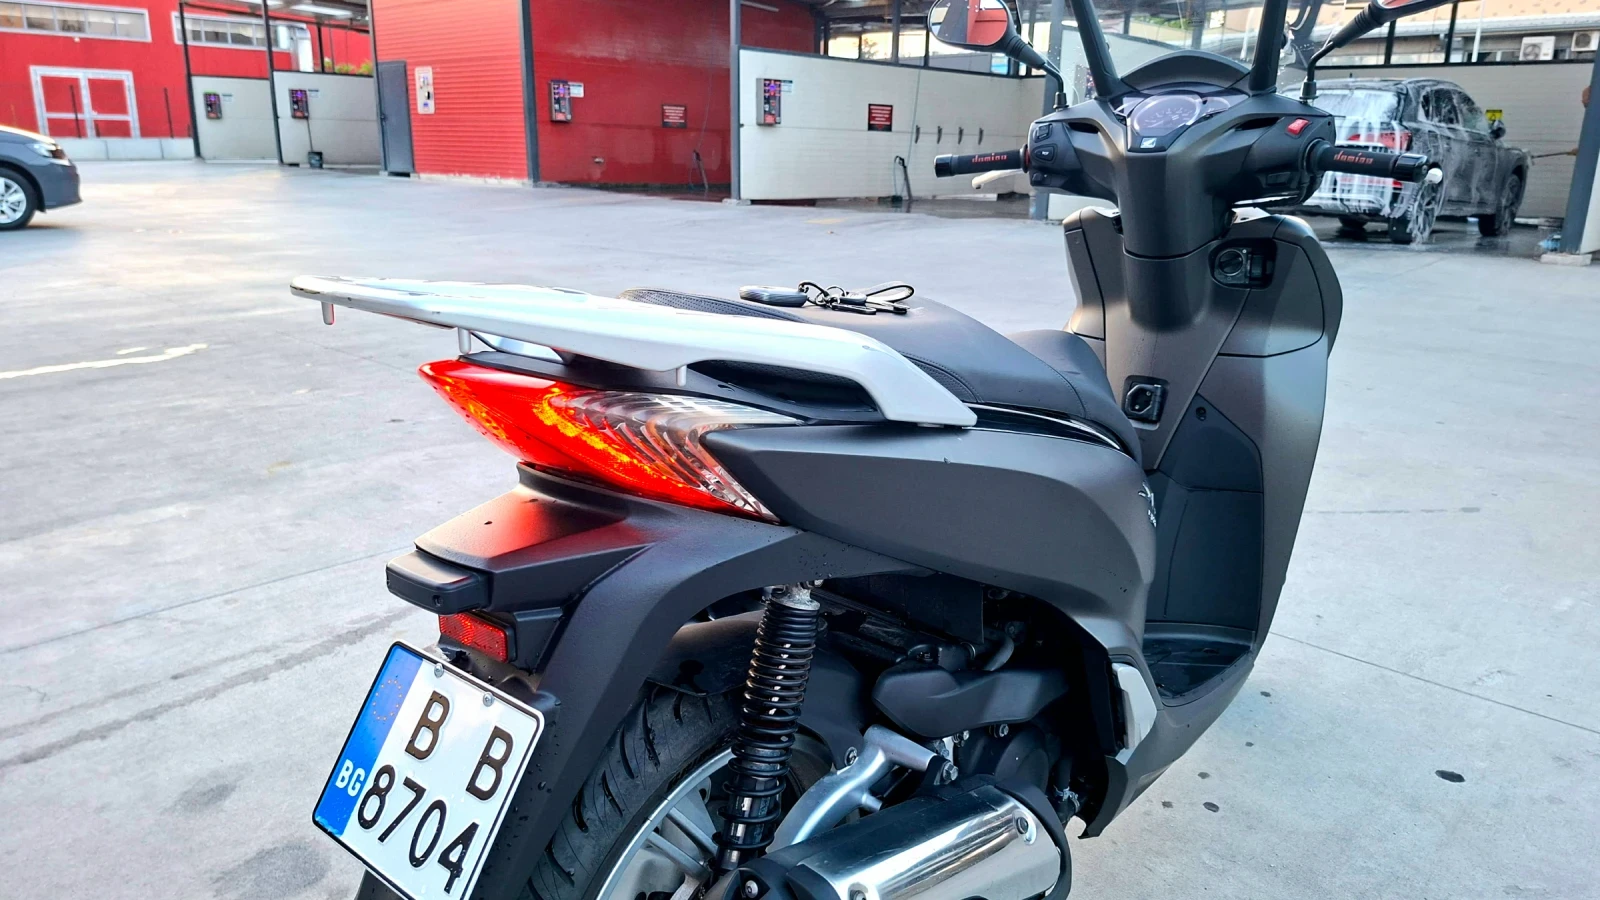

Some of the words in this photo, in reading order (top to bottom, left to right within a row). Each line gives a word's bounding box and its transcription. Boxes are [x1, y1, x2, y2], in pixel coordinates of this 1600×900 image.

[1333, 150, 1374, 165] domino
[335, 759, 366, 797] BG
[404, 690, 451, 761] B
[465, 725, 514, 801] B
[357, 764, 480, 895] 8704
